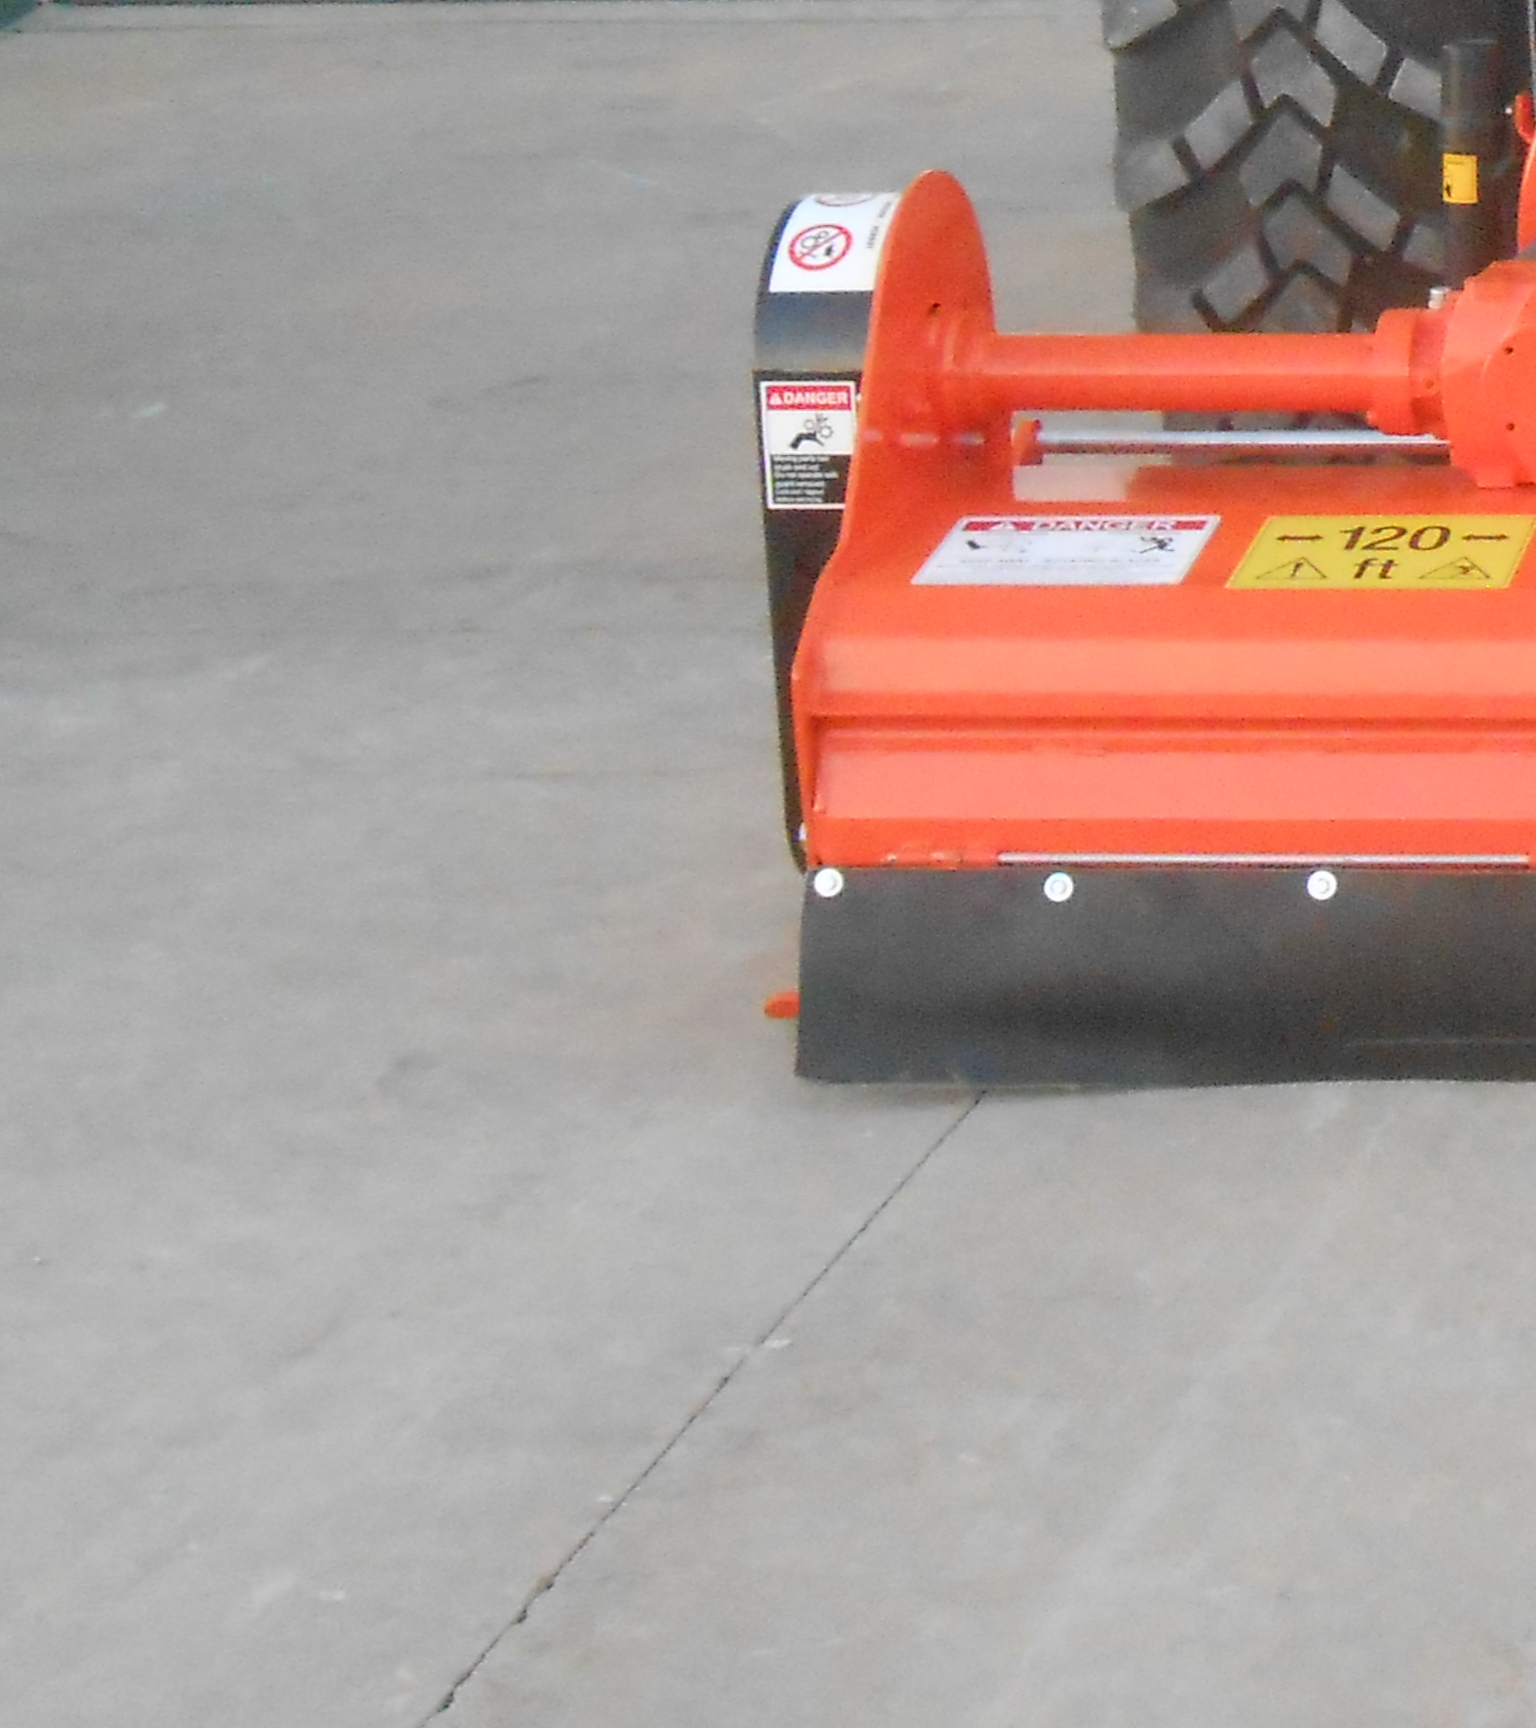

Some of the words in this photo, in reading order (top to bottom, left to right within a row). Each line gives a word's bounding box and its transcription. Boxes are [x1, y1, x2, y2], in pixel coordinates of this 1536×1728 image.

[783, 391, 849, 405] DANGER
[1031, 520, 1176, 531] DANGER
[1339, 525, 1451, 551] 120
[1352, 557, 1400, 580] ft
